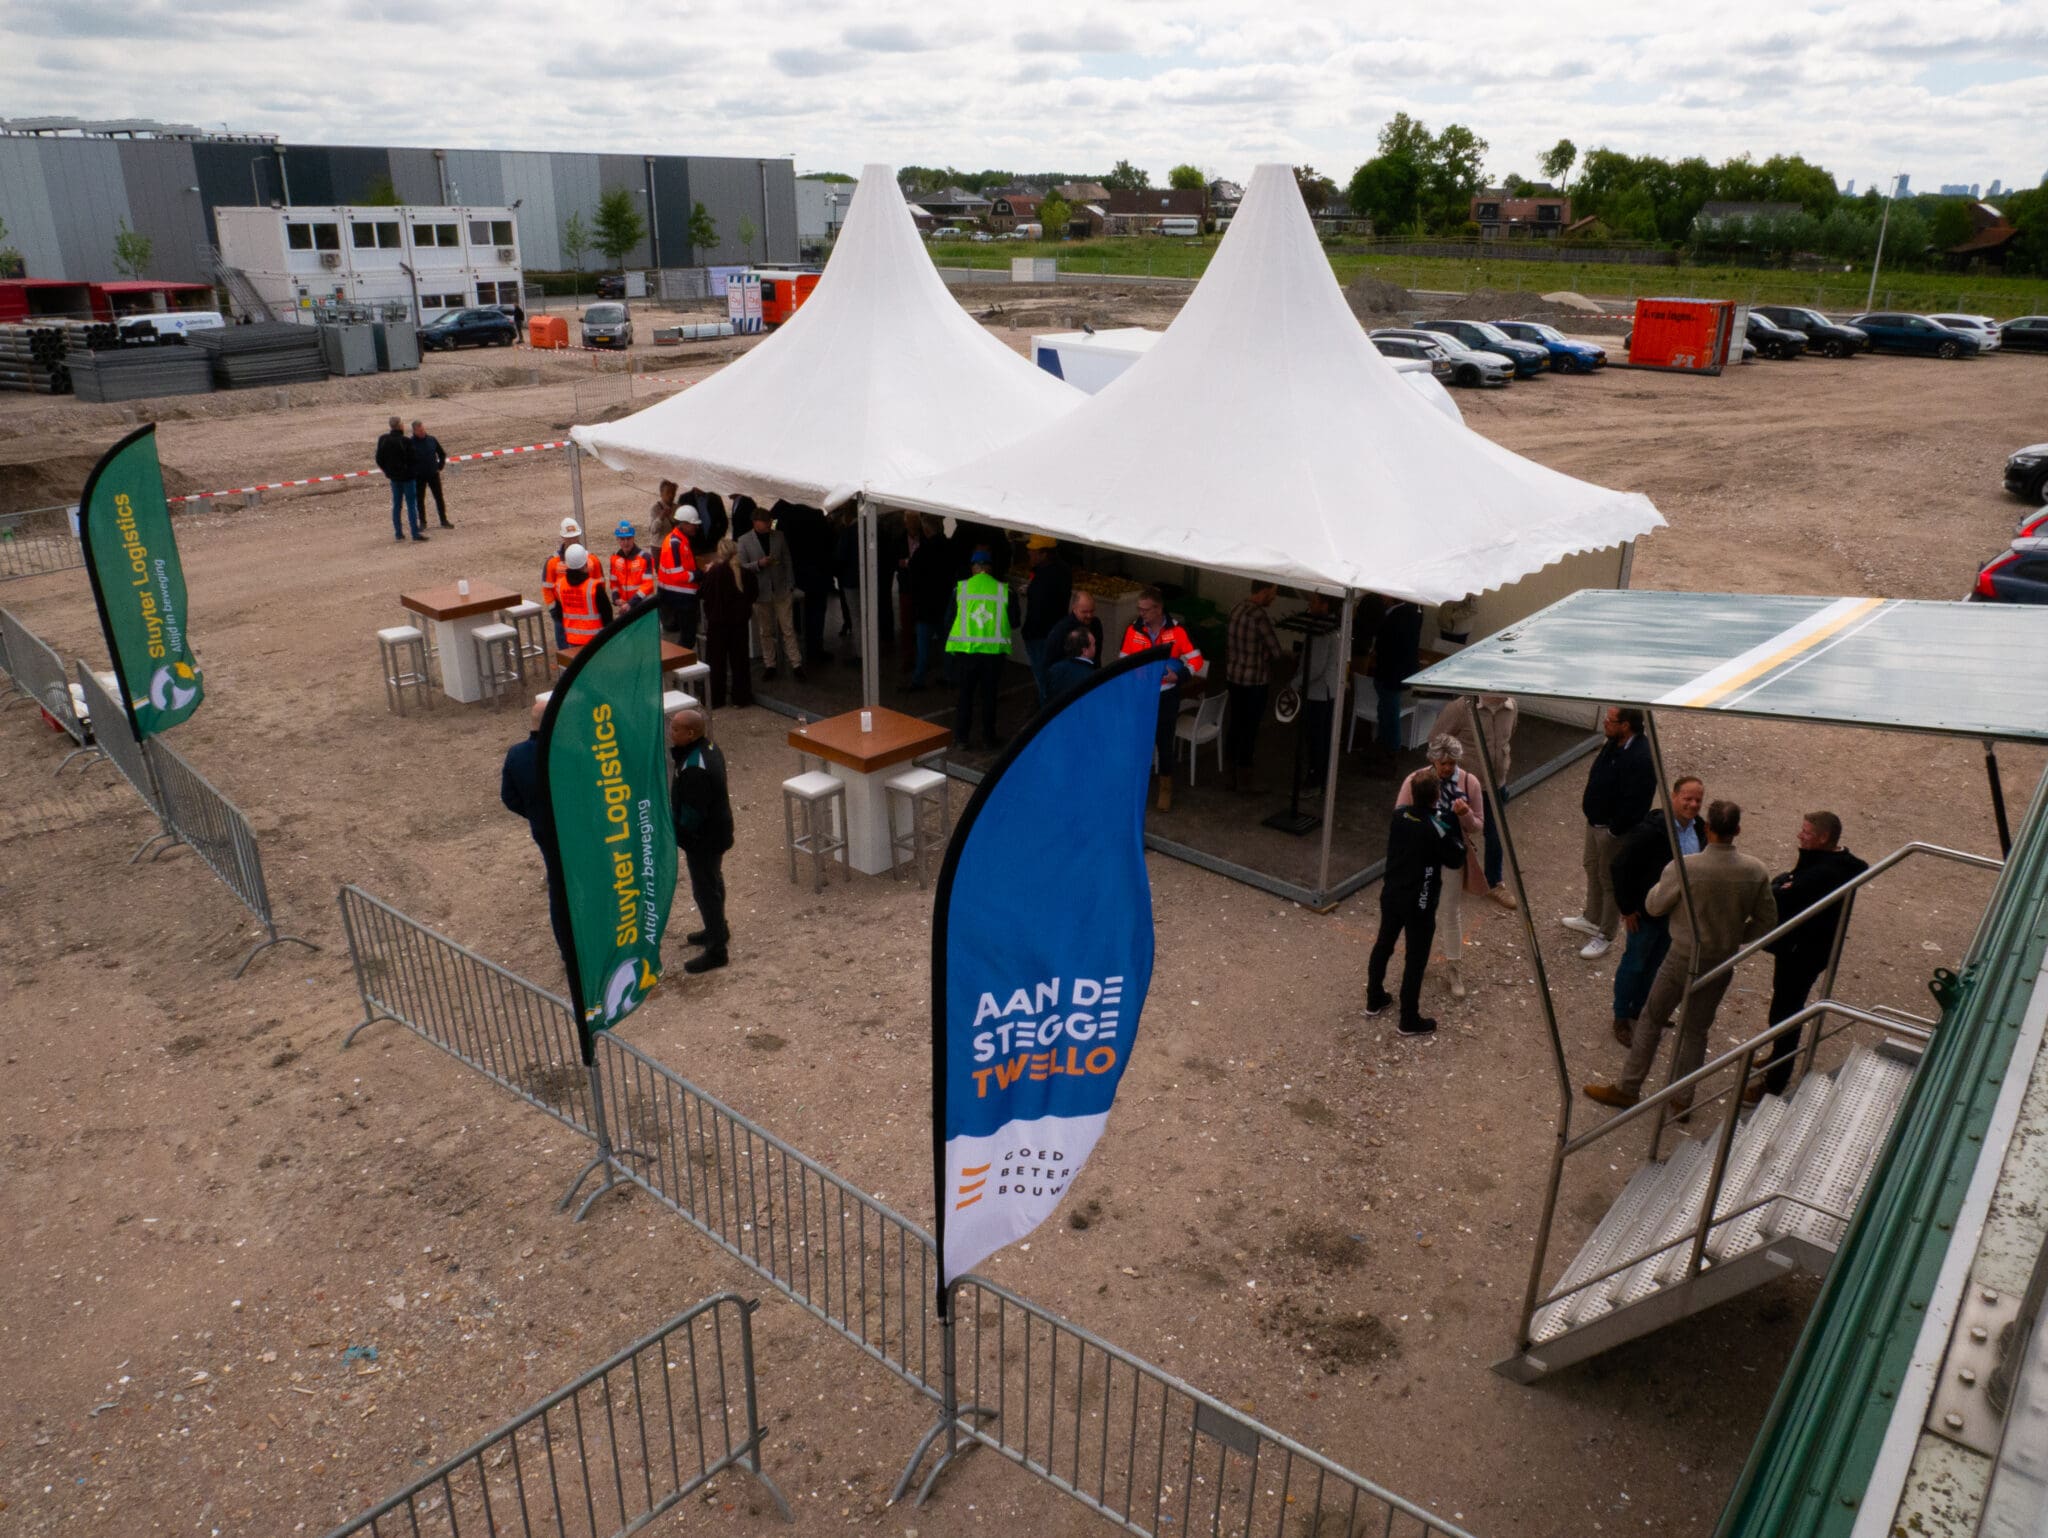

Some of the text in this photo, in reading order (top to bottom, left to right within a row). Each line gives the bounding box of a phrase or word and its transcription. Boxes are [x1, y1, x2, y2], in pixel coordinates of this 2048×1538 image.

[114, 493, 166, 659] Sluyter Logistics
[154, 559, 182, 652] Altijd in beweging
[591, 703, 641, 947] Sluyter Logistics
[638, 799, 659, 945] Altijd in beweging
[973, 976, 1124, 1027] AAN DE
[973, 1010, 1120, 1063] STEGGE
[972, 1046, 1116, 1098] TWELLO
[1000, 1165, 1080, 1179] BETER
[1004, 1147, 1064, 1161] GOED
